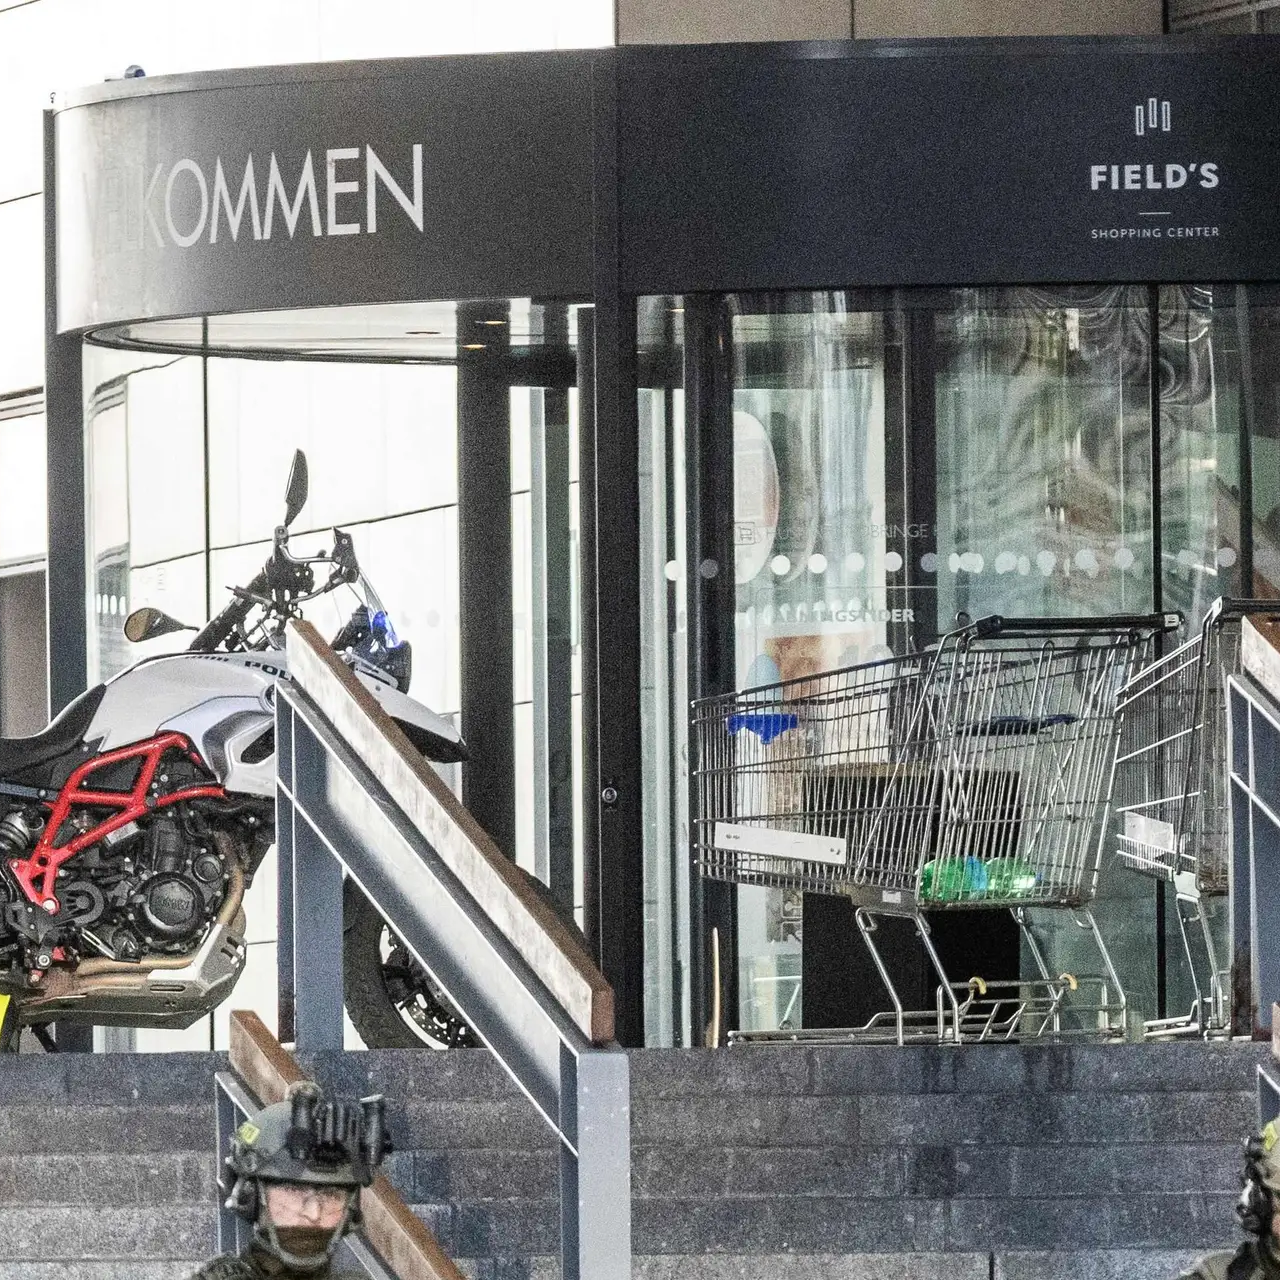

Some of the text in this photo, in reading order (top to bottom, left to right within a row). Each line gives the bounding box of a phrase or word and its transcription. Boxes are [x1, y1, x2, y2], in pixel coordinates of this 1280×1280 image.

[1090, 162, 1220, 190] FIELD'S
[1091, 226, 1220, 239] SHOPPING CENTER
[244, 660, 292, 681] POL
